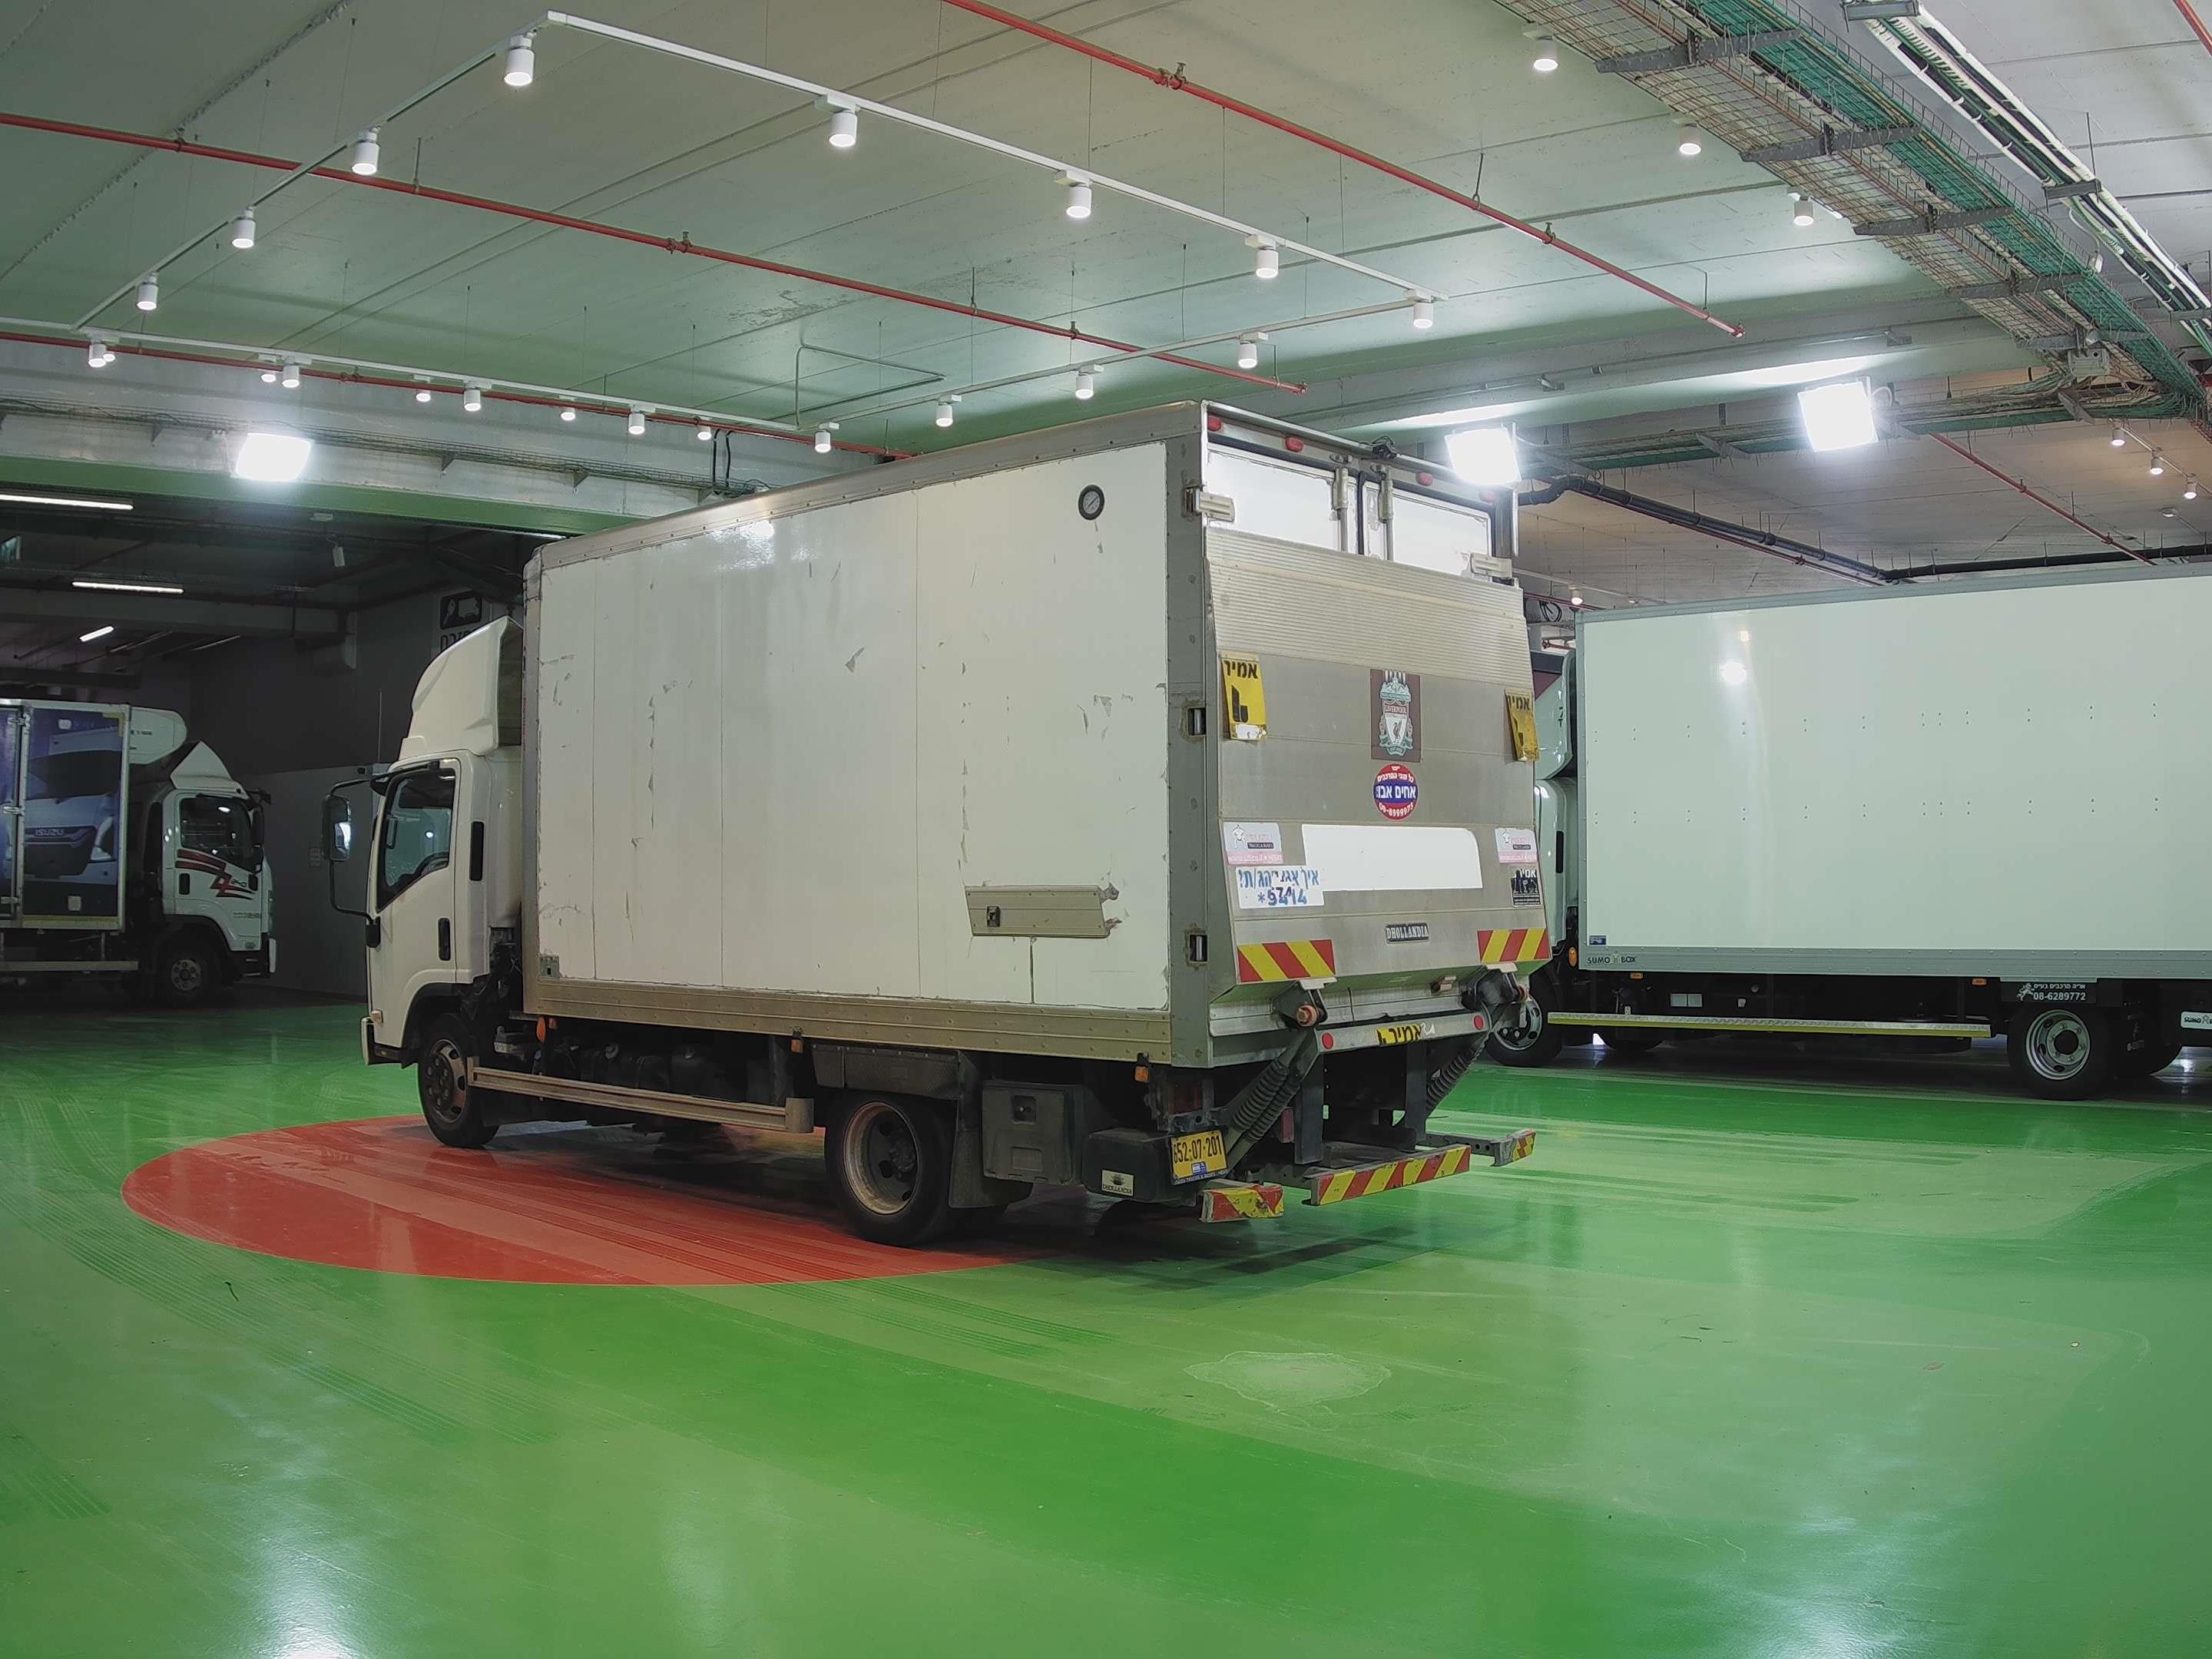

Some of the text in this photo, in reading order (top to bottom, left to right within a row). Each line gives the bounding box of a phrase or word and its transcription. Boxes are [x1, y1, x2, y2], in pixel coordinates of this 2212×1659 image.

[1224, 661, 1258, 679] אמיר
[1395, 785, 1416, 800] אחים
[1386, 925, 1429, 939] DHOLLANDIA
[2033, 992, 2086, 1001] 08-6289772
